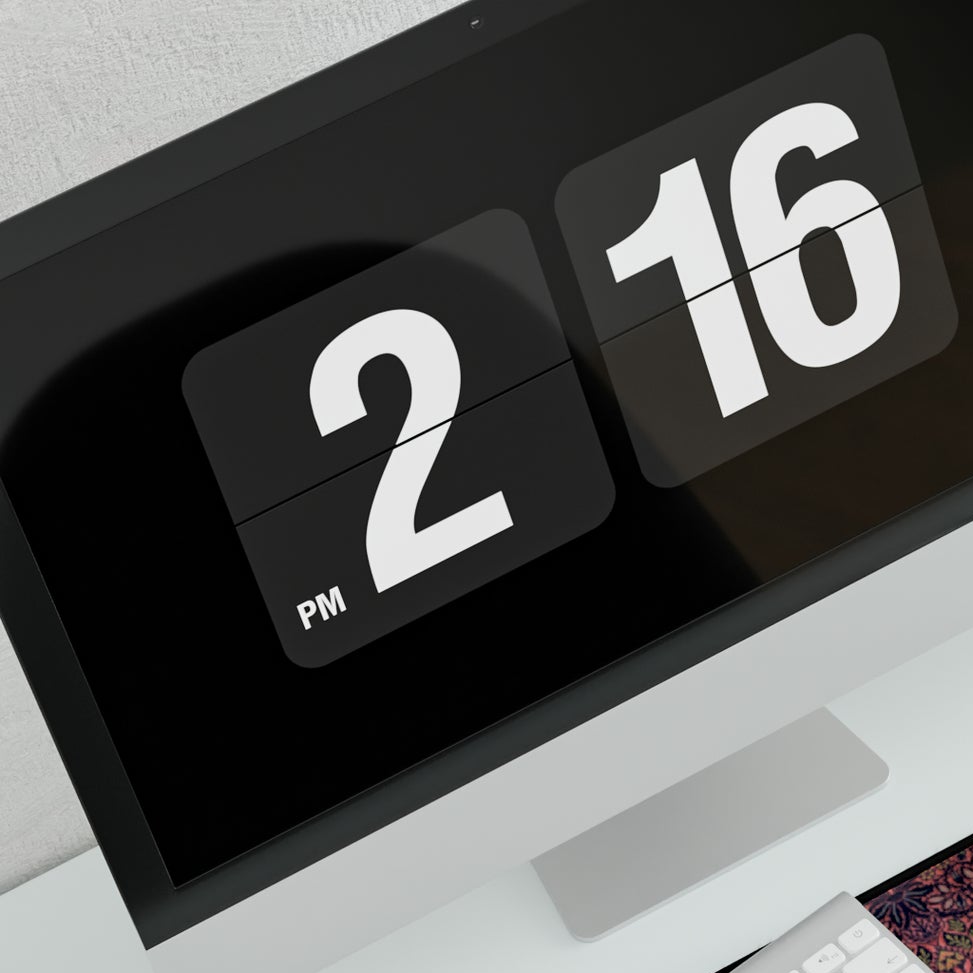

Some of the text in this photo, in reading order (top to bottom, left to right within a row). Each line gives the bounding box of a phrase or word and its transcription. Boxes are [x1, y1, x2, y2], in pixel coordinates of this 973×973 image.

[310, 103, 901, 594] 2 16
[296, 585, 347, 630] PM
